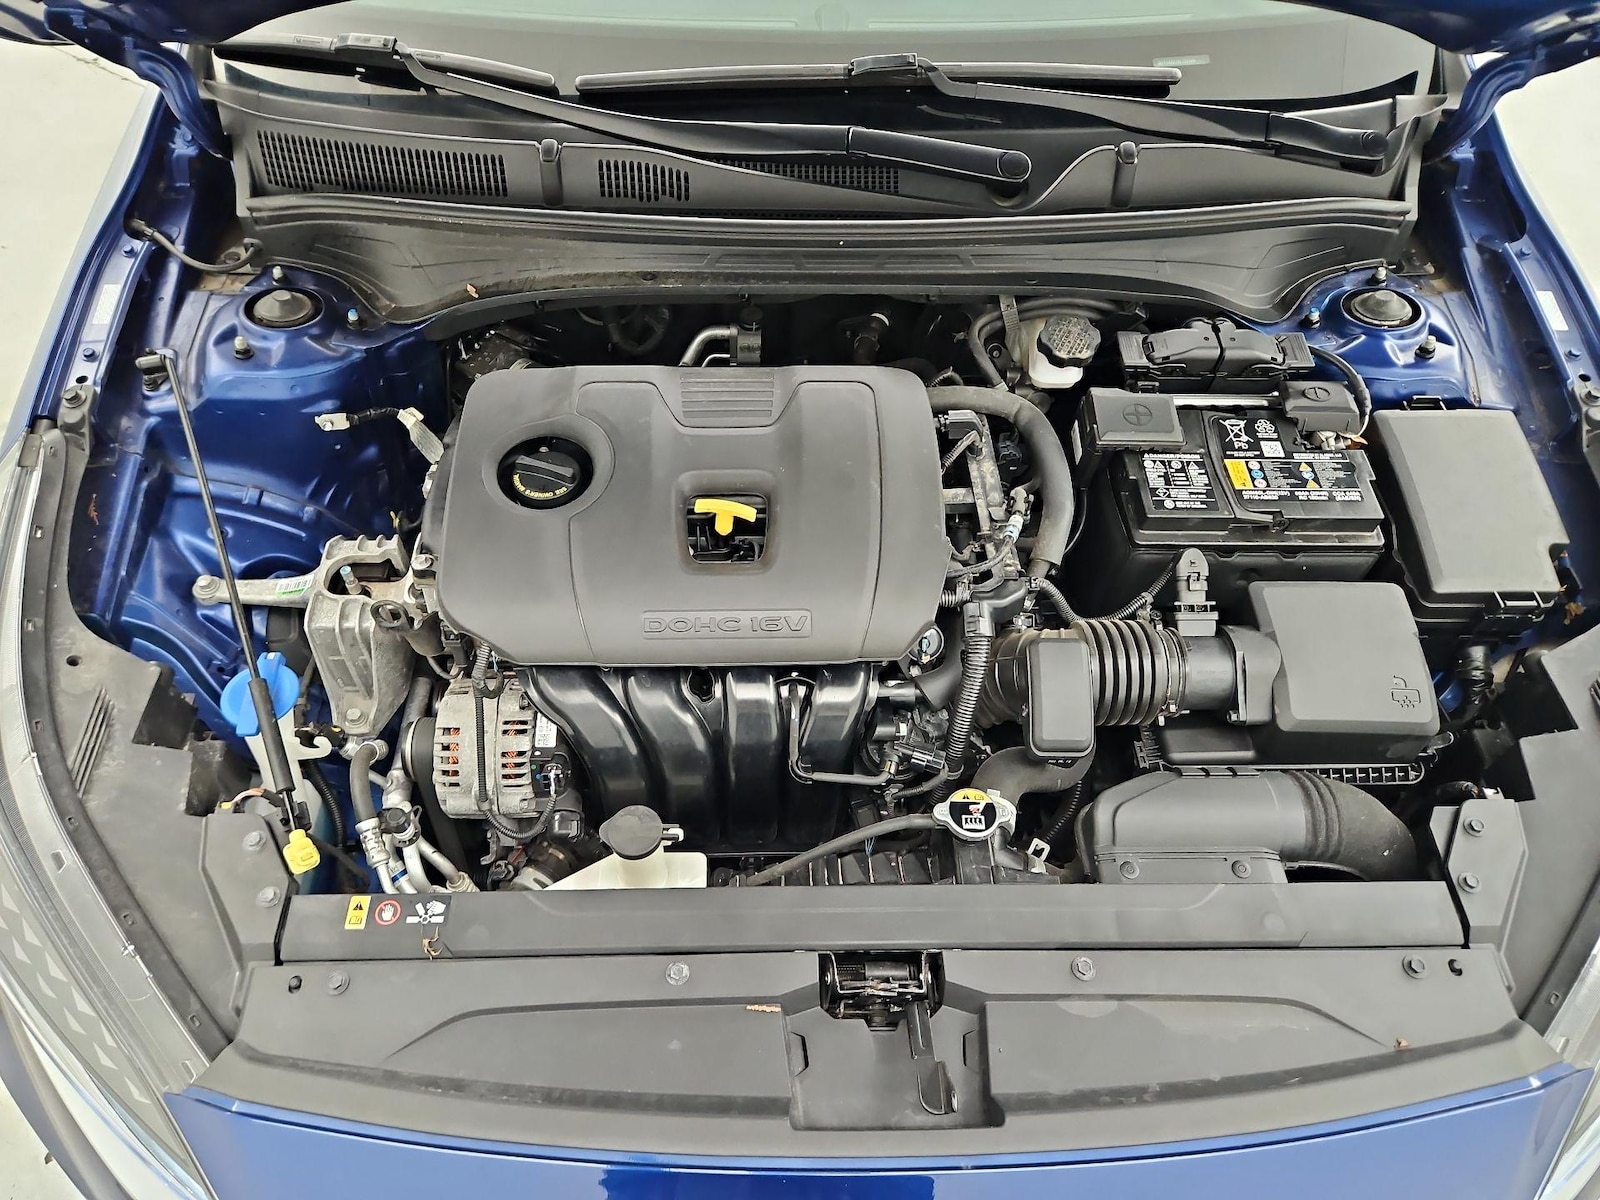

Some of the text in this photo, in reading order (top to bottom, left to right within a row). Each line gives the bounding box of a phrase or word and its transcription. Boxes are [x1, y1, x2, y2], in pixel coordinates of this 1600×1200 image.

[1233, 441, 1249, 449] Pb
[554, 486, 567, 495] SEE
[643, 615, 808, 633] DOHC 16V
